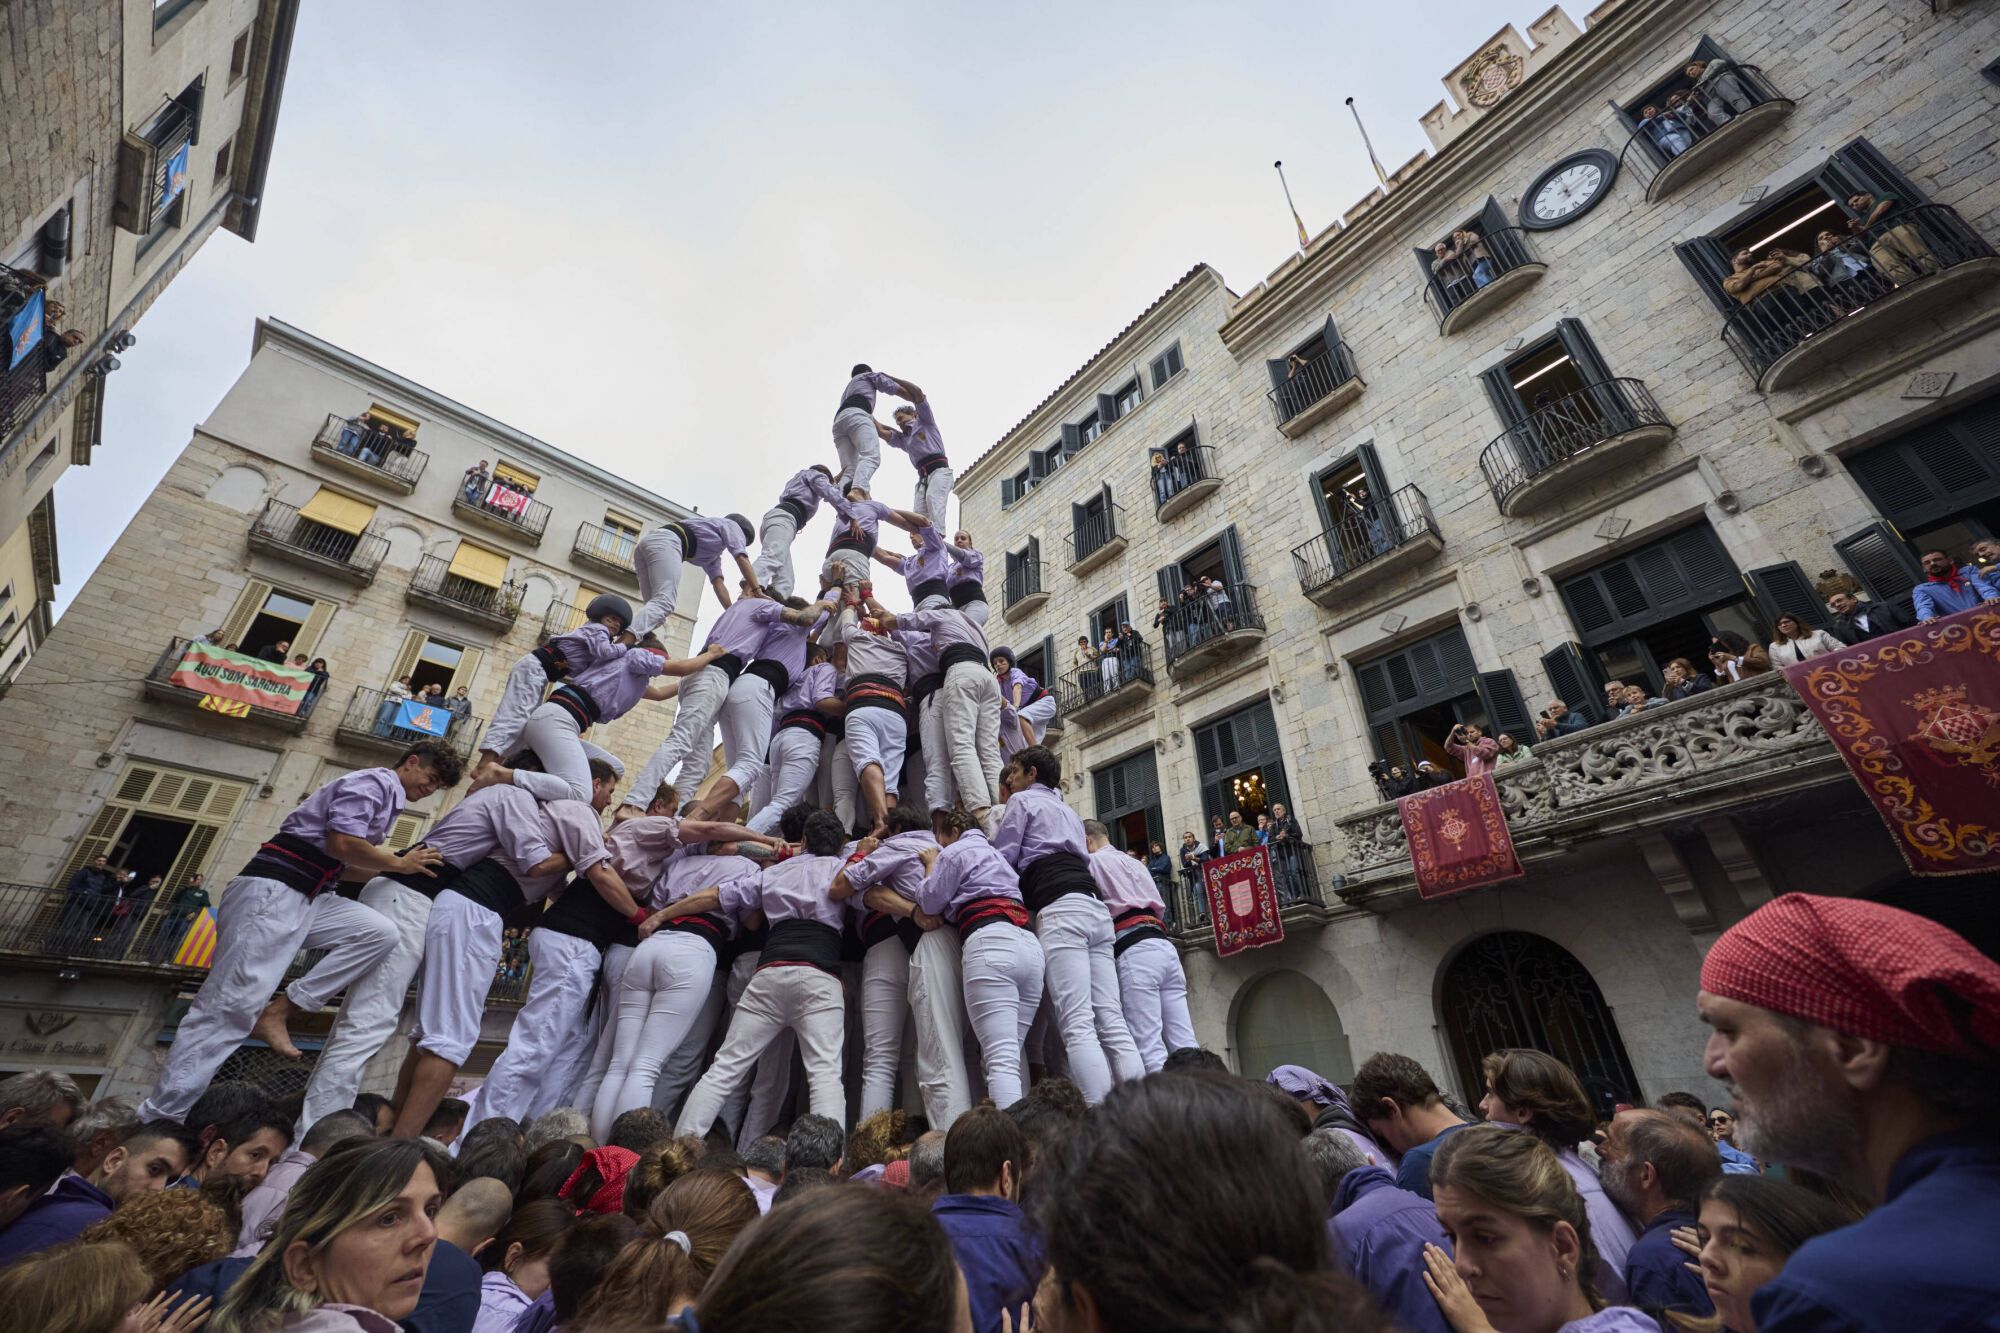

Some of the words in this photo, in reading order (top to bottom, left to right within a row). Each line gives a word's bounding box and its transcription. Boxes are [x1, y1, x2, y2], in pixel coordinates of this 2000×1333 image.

[194, 661, 223, 677] AQUÍ
[220, 668, 246, 684] SOM
[244, 674, 292, 696] SARRIERA
